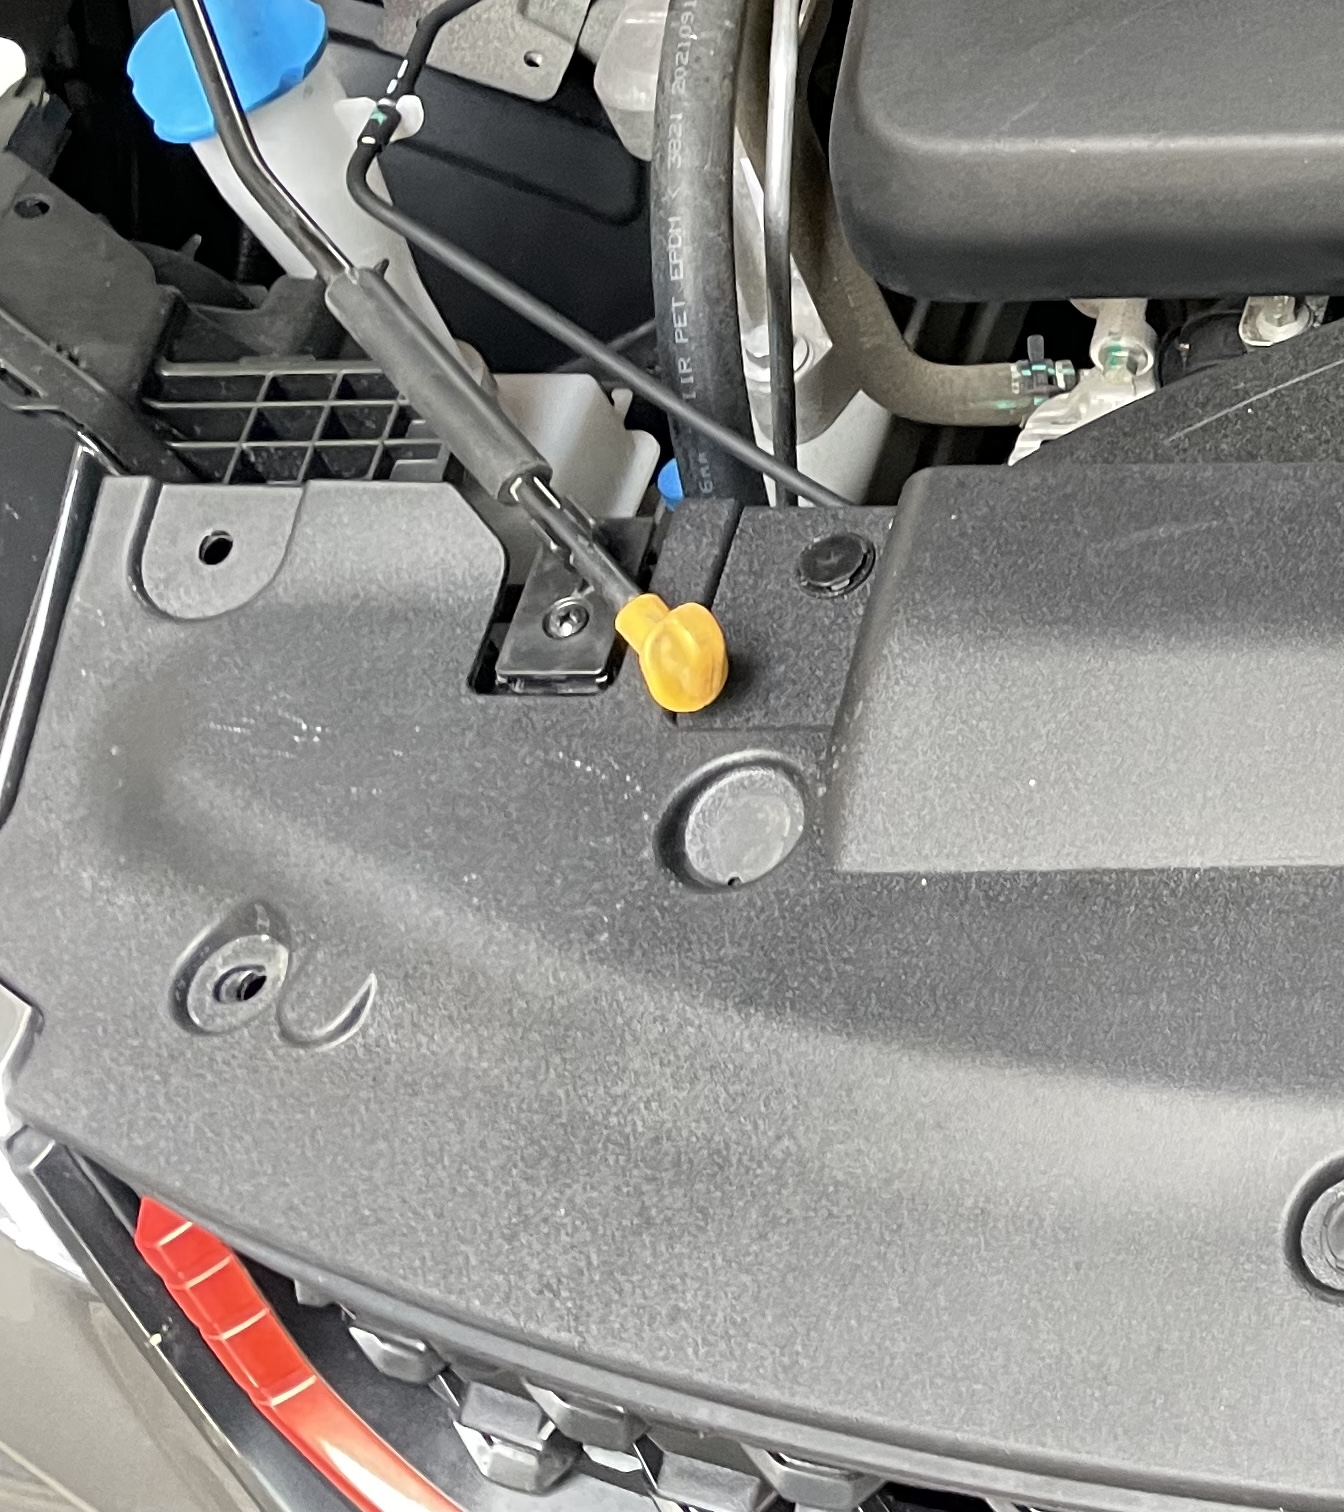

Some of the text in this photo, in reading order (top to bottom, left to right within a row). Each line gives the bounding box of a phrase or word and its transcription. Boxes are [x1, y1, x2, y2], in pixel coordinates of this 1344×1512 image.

[668, 112, 684, 169] 3821
[668, 215, 685, 282] EPDM
[671, 296, 690, 344] PET
